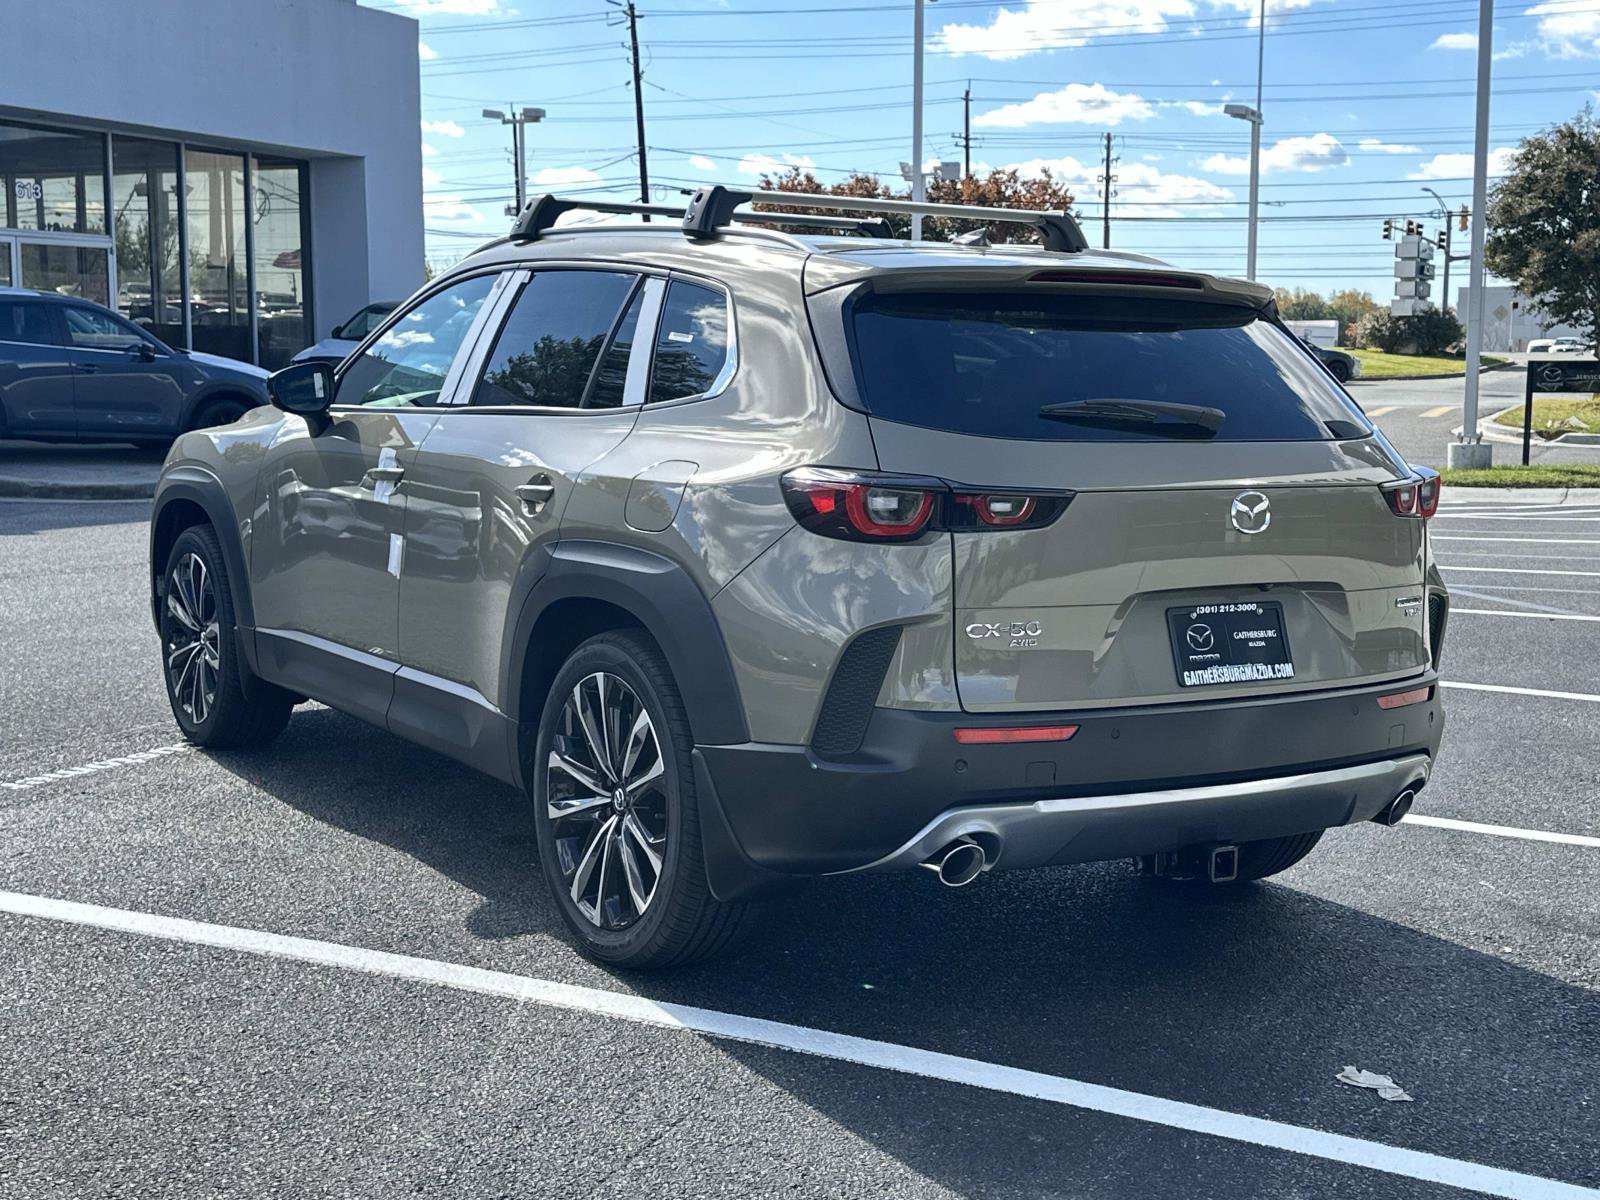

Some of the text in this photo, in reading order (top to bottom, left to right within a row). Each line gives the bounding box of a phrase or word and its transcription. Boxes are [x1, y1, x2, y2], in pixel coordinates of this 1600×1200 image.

[15, 181, 42, 200] 613
[1196, 603, 1257, 614] (301) 212-3000
[965, 620, 1042, 639] CX-50
[1233, 630, 1278, 639] GAITHERSBURG
[1009, 639, 1038, 647] AWD
[1183, 662, 1295, 686] GAITHERSBURGMAZDA.COM
